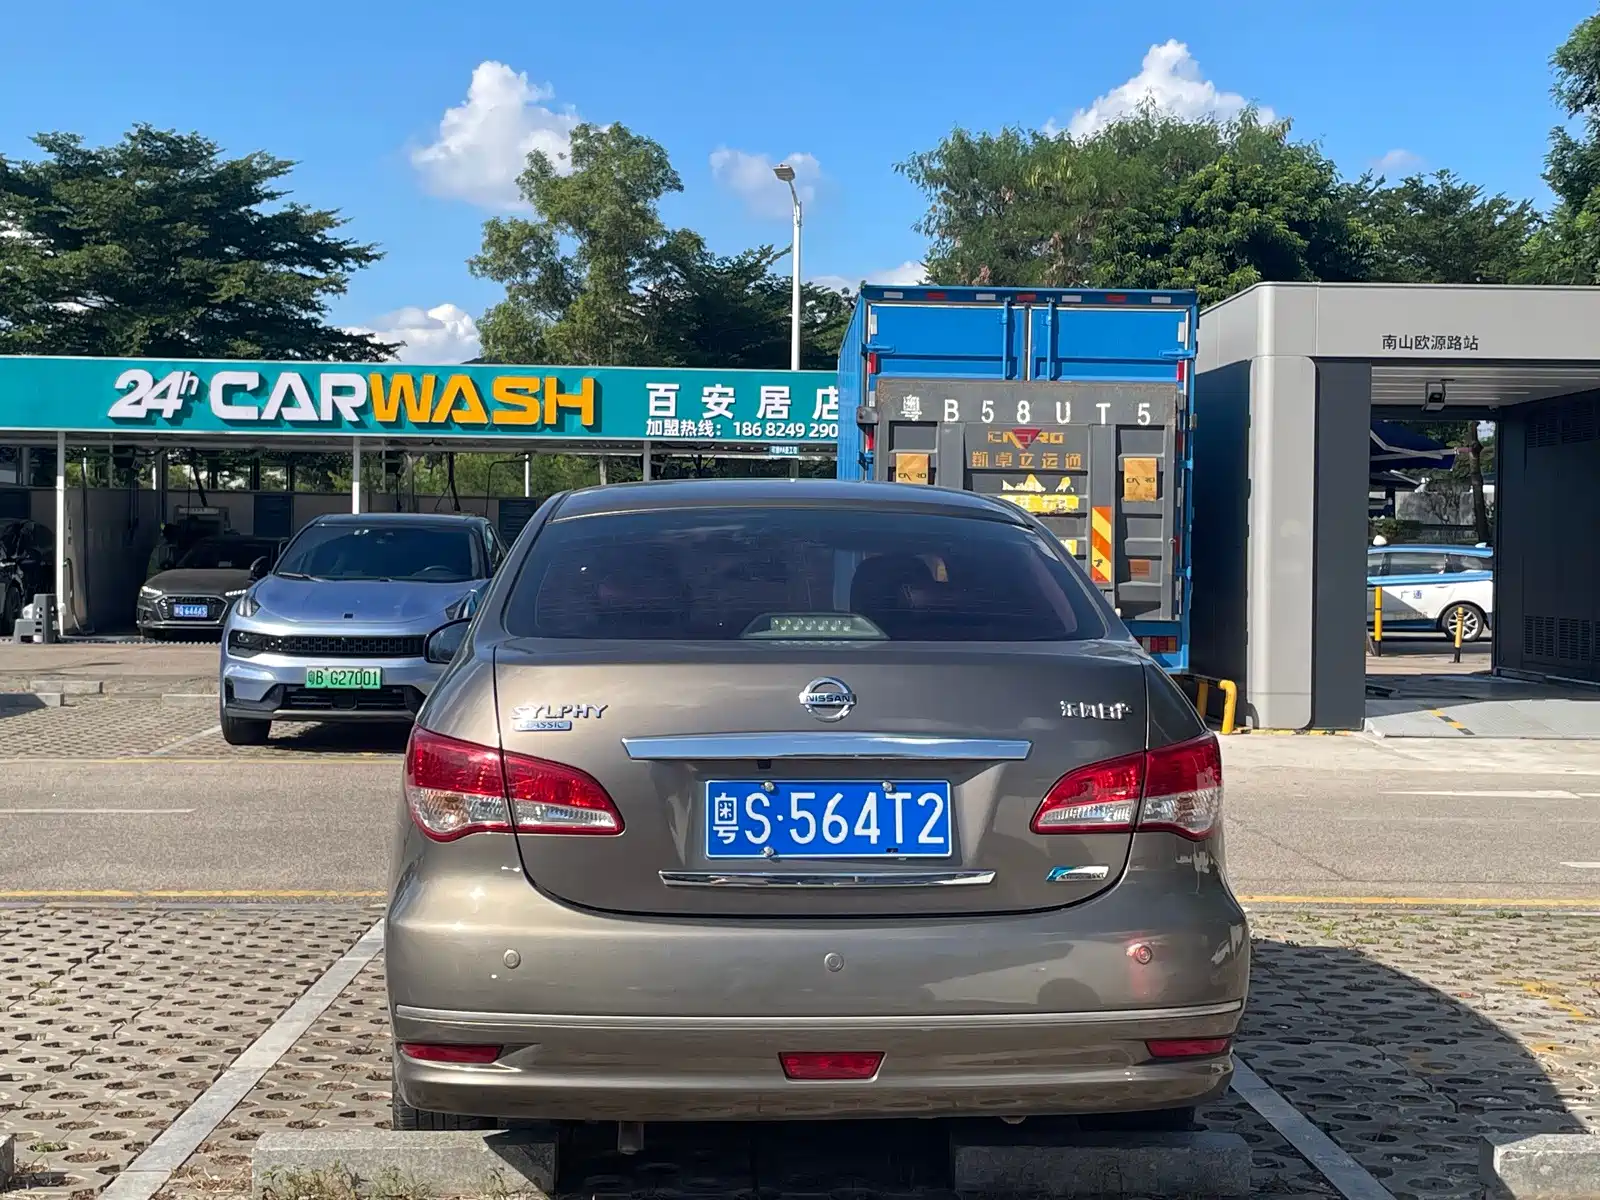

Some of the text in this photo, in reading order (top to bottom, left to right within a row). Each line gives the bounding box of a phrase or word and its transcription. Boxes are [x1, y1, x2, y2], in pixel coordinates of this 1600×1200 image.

[1382, 334, 1479, 351] 南山欧源路站
[108, 368, 199, 418] 24h
[645, 382, 838, 420] 百安居店
[733, 421, 762, 437] 186
[765, 421, 806, 438] 8249
[806, 694, 850, 703] NISSAN
[511, 704, 609, 719] SYLPHY
